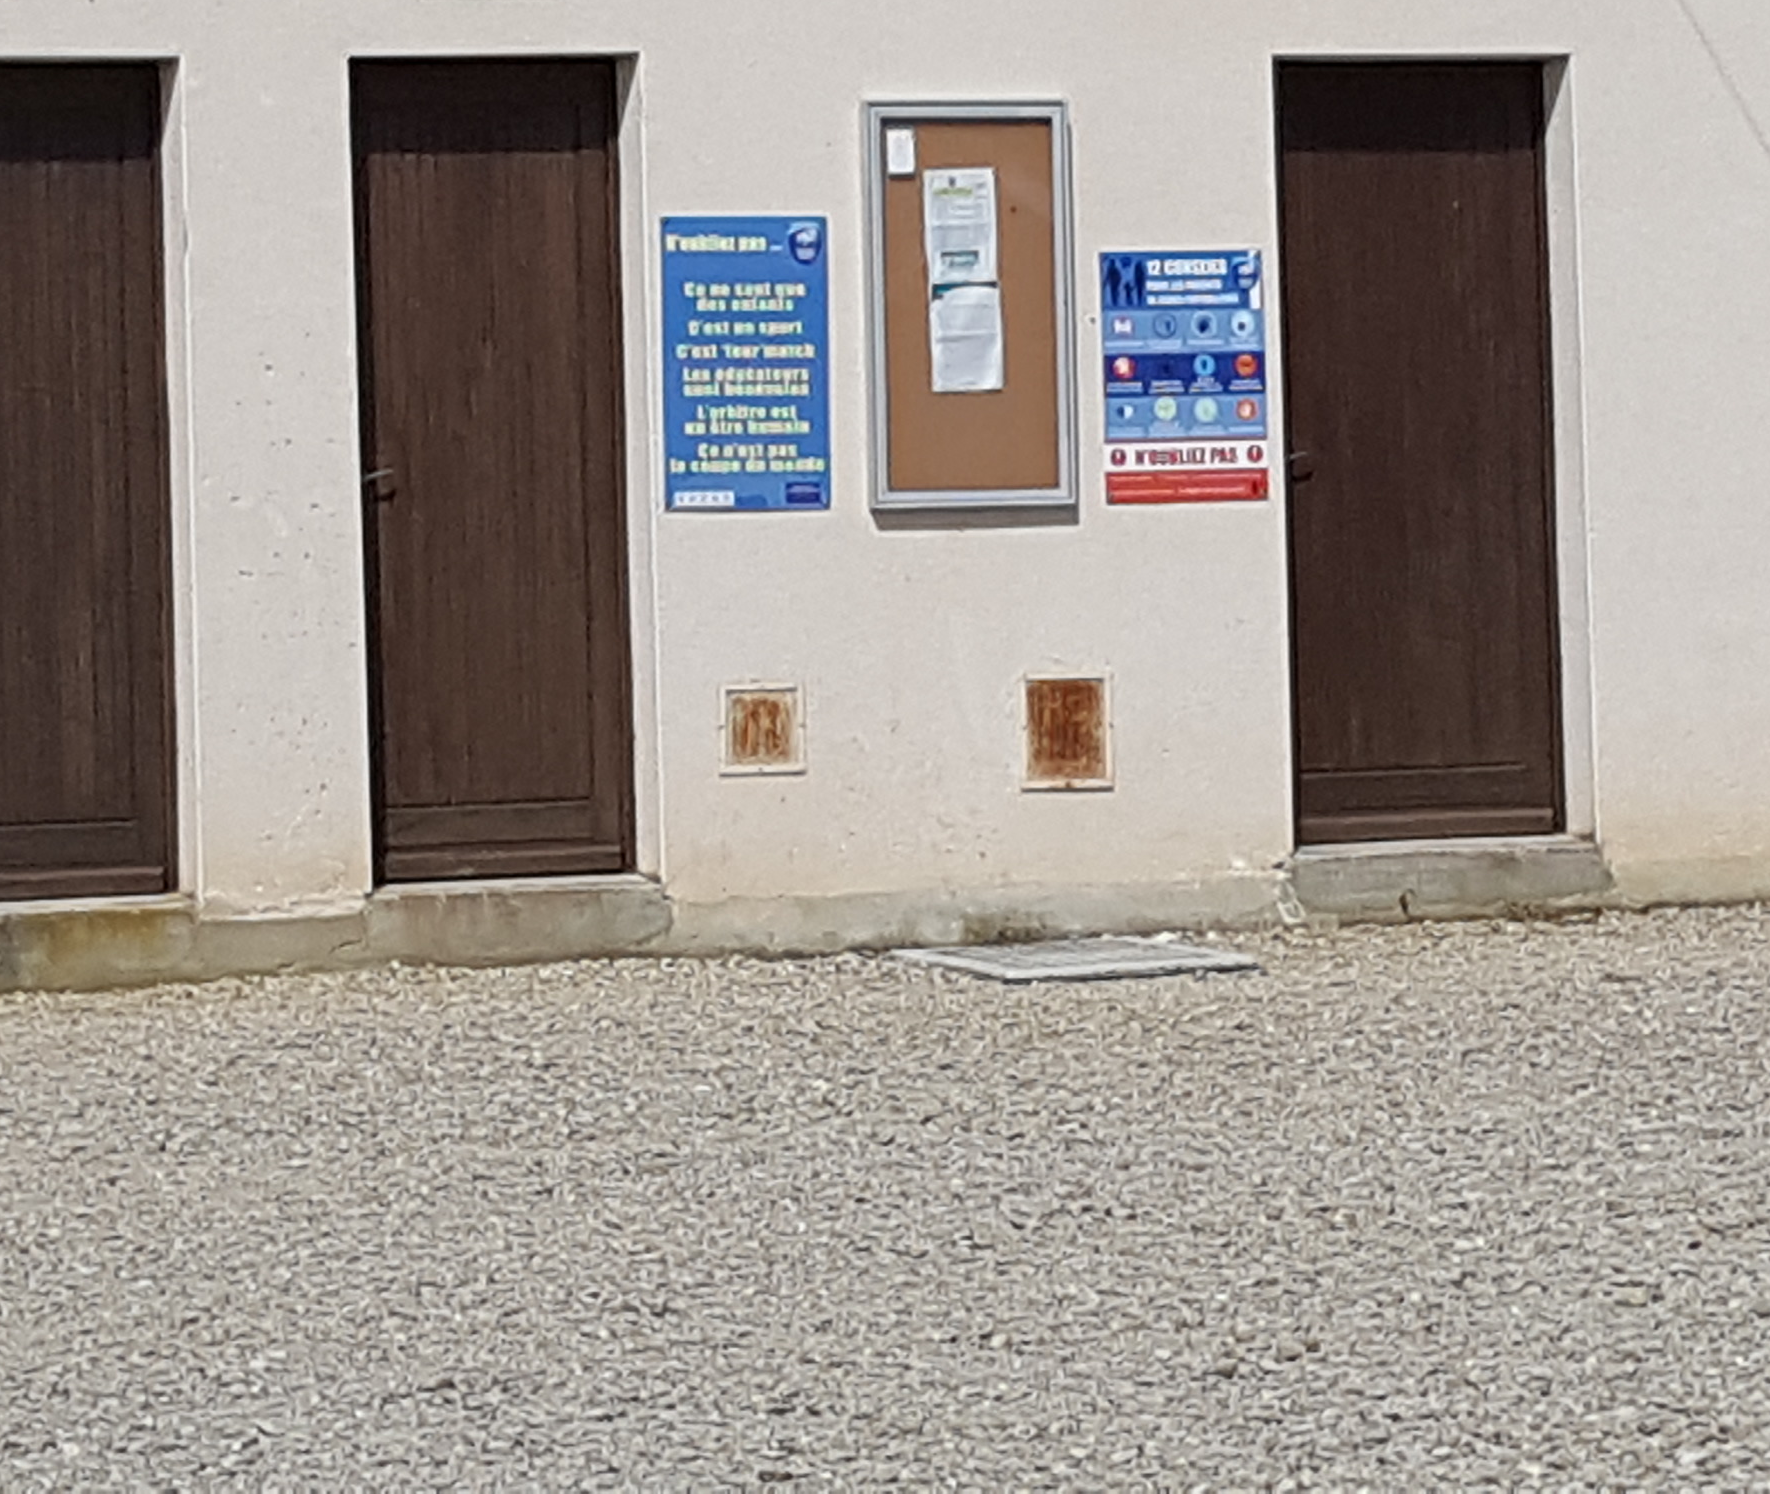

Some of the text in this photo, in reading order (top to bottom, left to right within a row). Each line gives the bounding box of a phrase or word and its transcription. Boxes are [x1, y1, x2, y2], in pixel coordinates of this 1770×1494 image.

[696, 297, 794, 311] des enfants
[683, 367, 710, 381] Les
